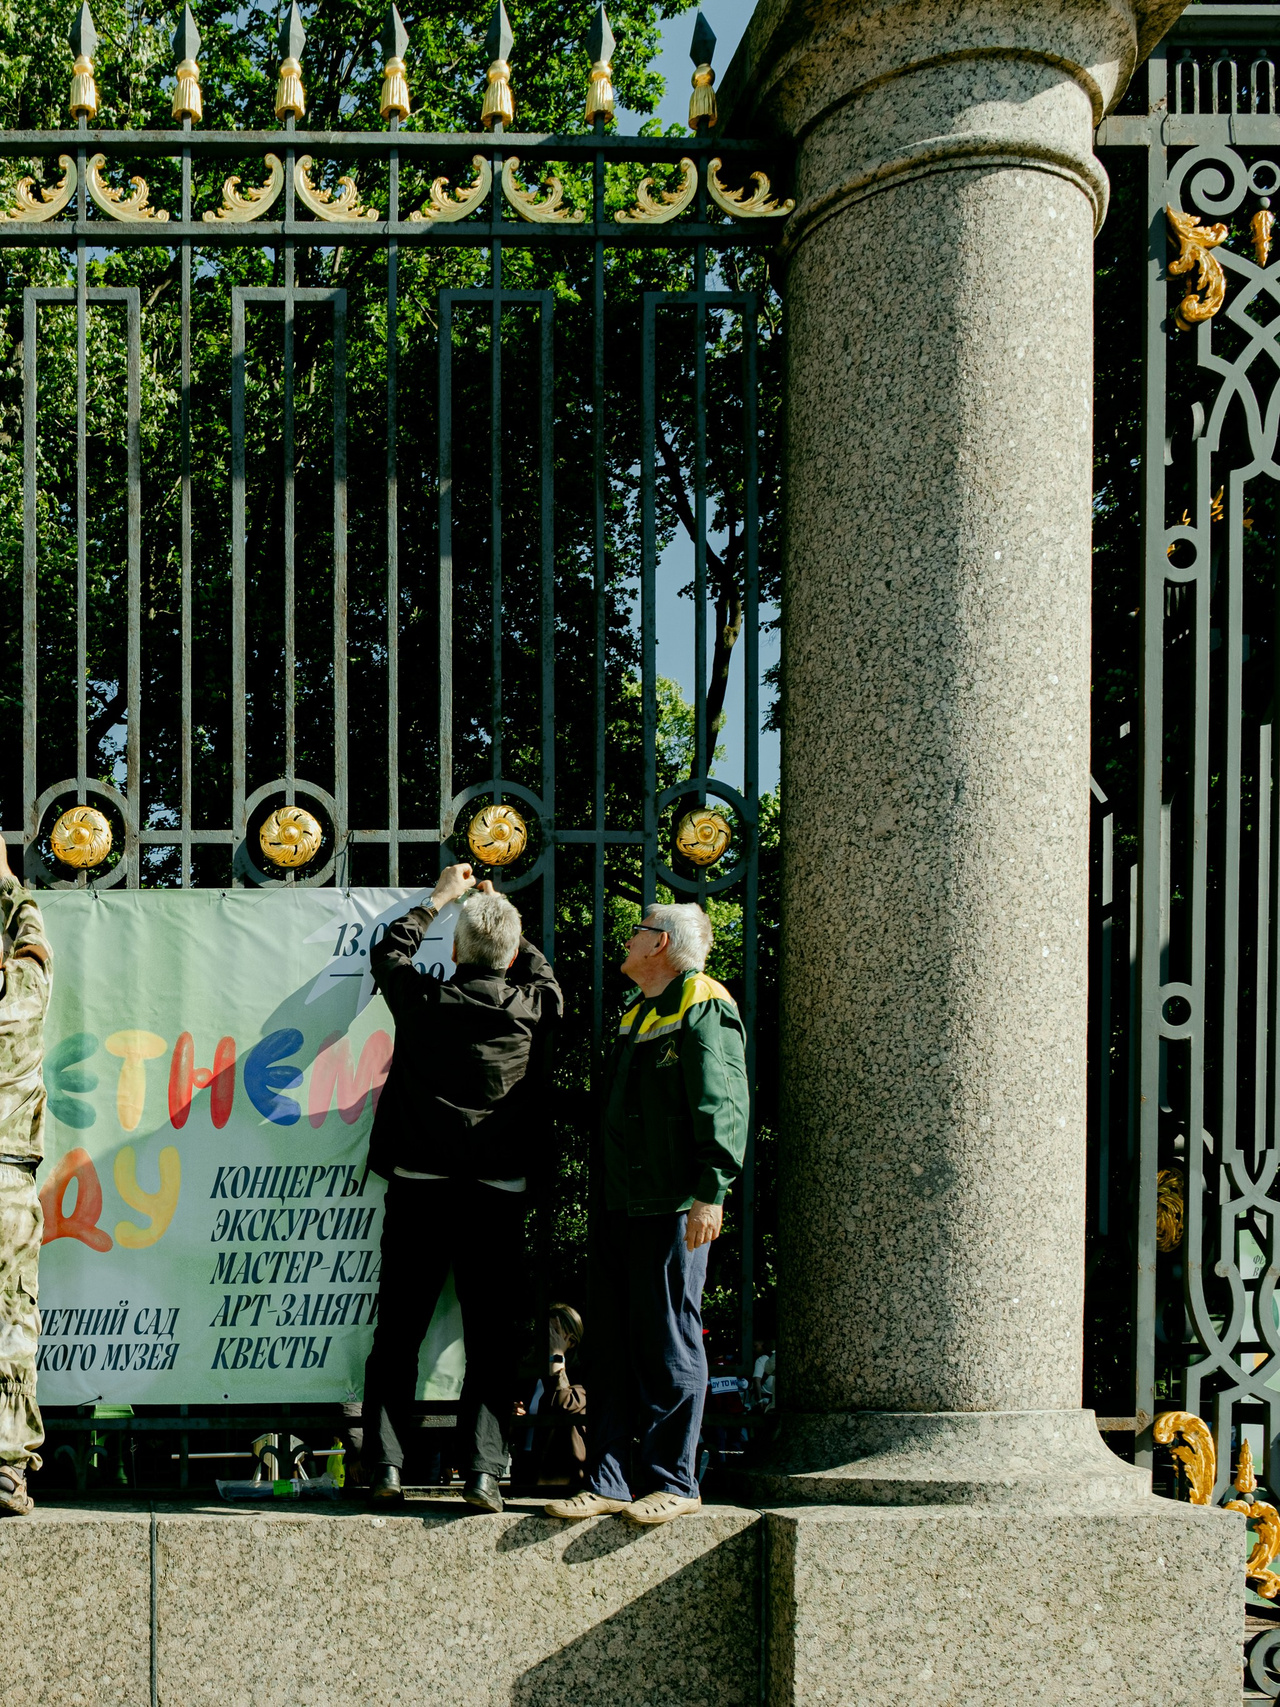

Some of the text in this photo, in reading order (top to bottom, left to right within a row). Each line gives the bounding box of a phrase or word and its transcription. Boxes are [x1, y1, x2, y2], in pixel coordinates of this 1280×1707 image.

[43, 1027, 395, 1131] ЕТНЕМ
[210, 1165, 369, 1206] КОНЦЕРТЫ
[210, 1207, 377, 1242] ЭКСКУРСИИ
[133, 1308, 180, 1341] САД
[101, 1343, 180, 1372] МУЗЕЯ
[210, 1336, 332, 1370] КВЕСТЫ
